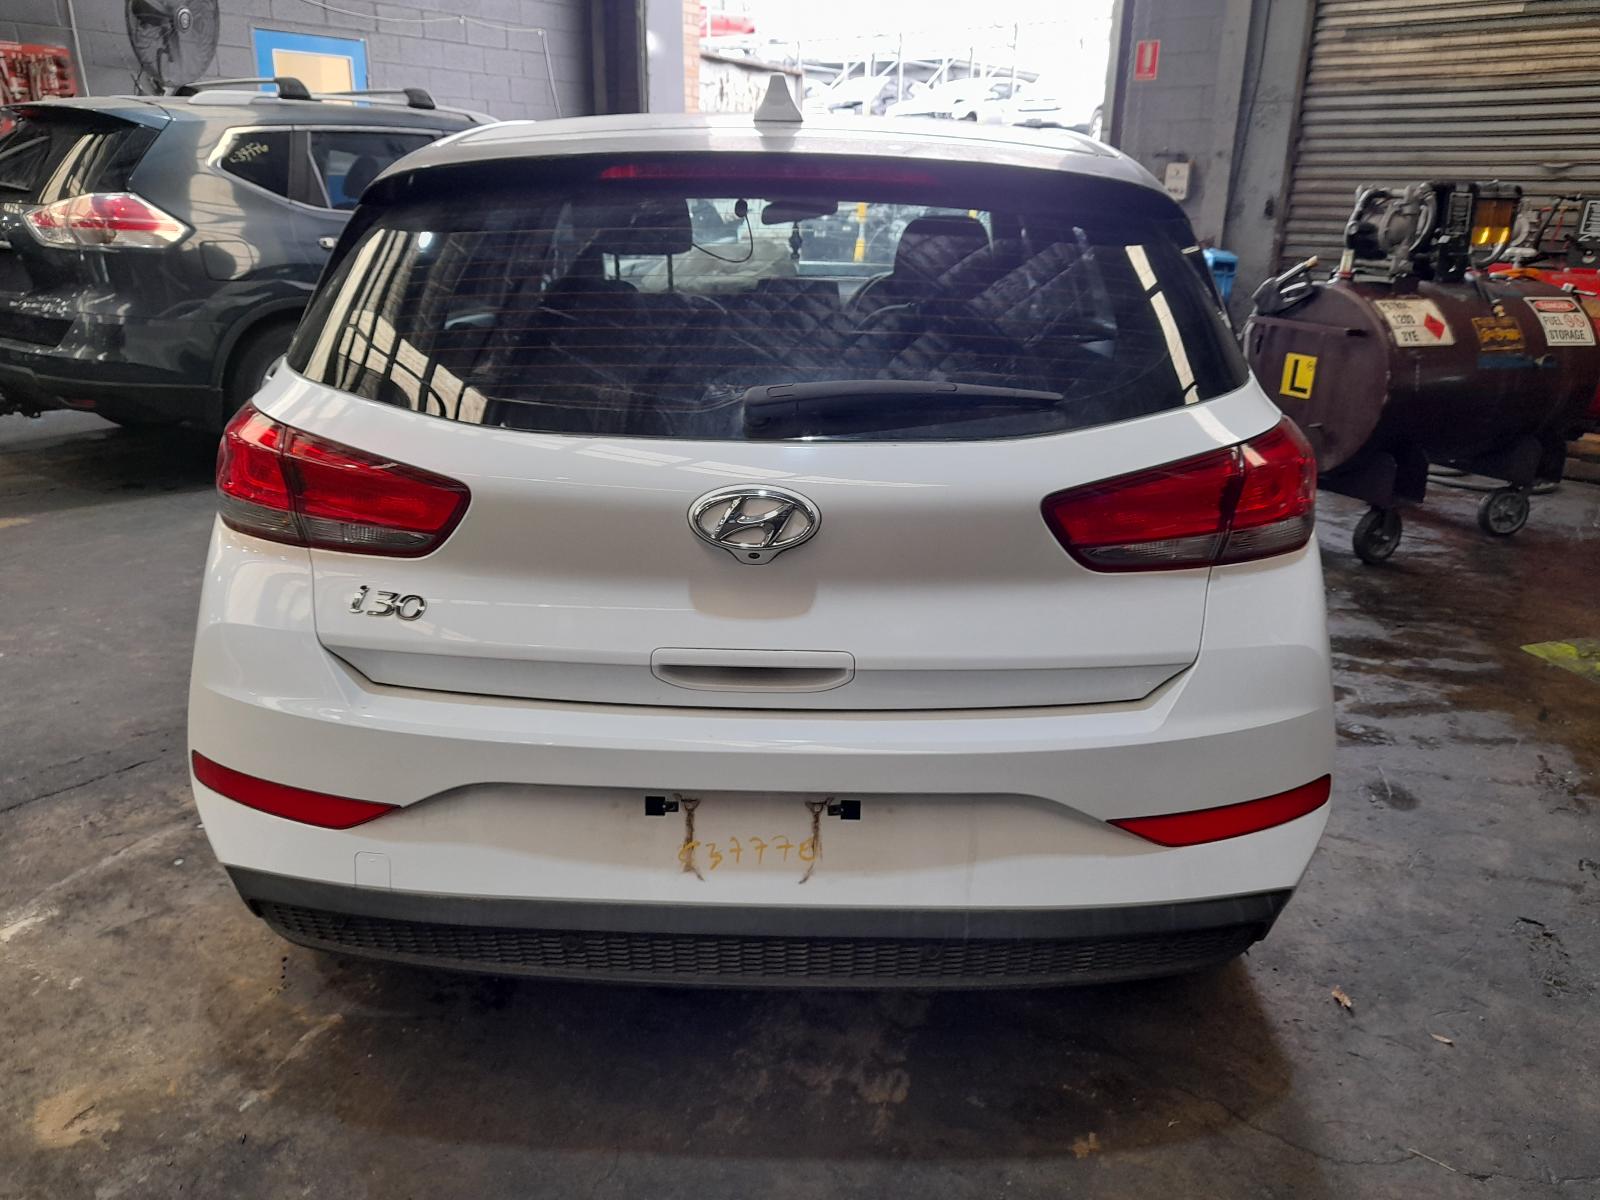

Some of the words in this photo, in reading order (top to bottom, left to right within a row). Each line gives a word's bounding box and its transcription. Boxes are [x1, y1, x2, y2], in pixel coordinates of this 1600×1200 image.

[1542, 316, 1564, 326] FUEL
[1549, 330, 1585, 340] STORAGE
[1288, 360, 1307, 394] L
[349, 585, 427, 622] i30
